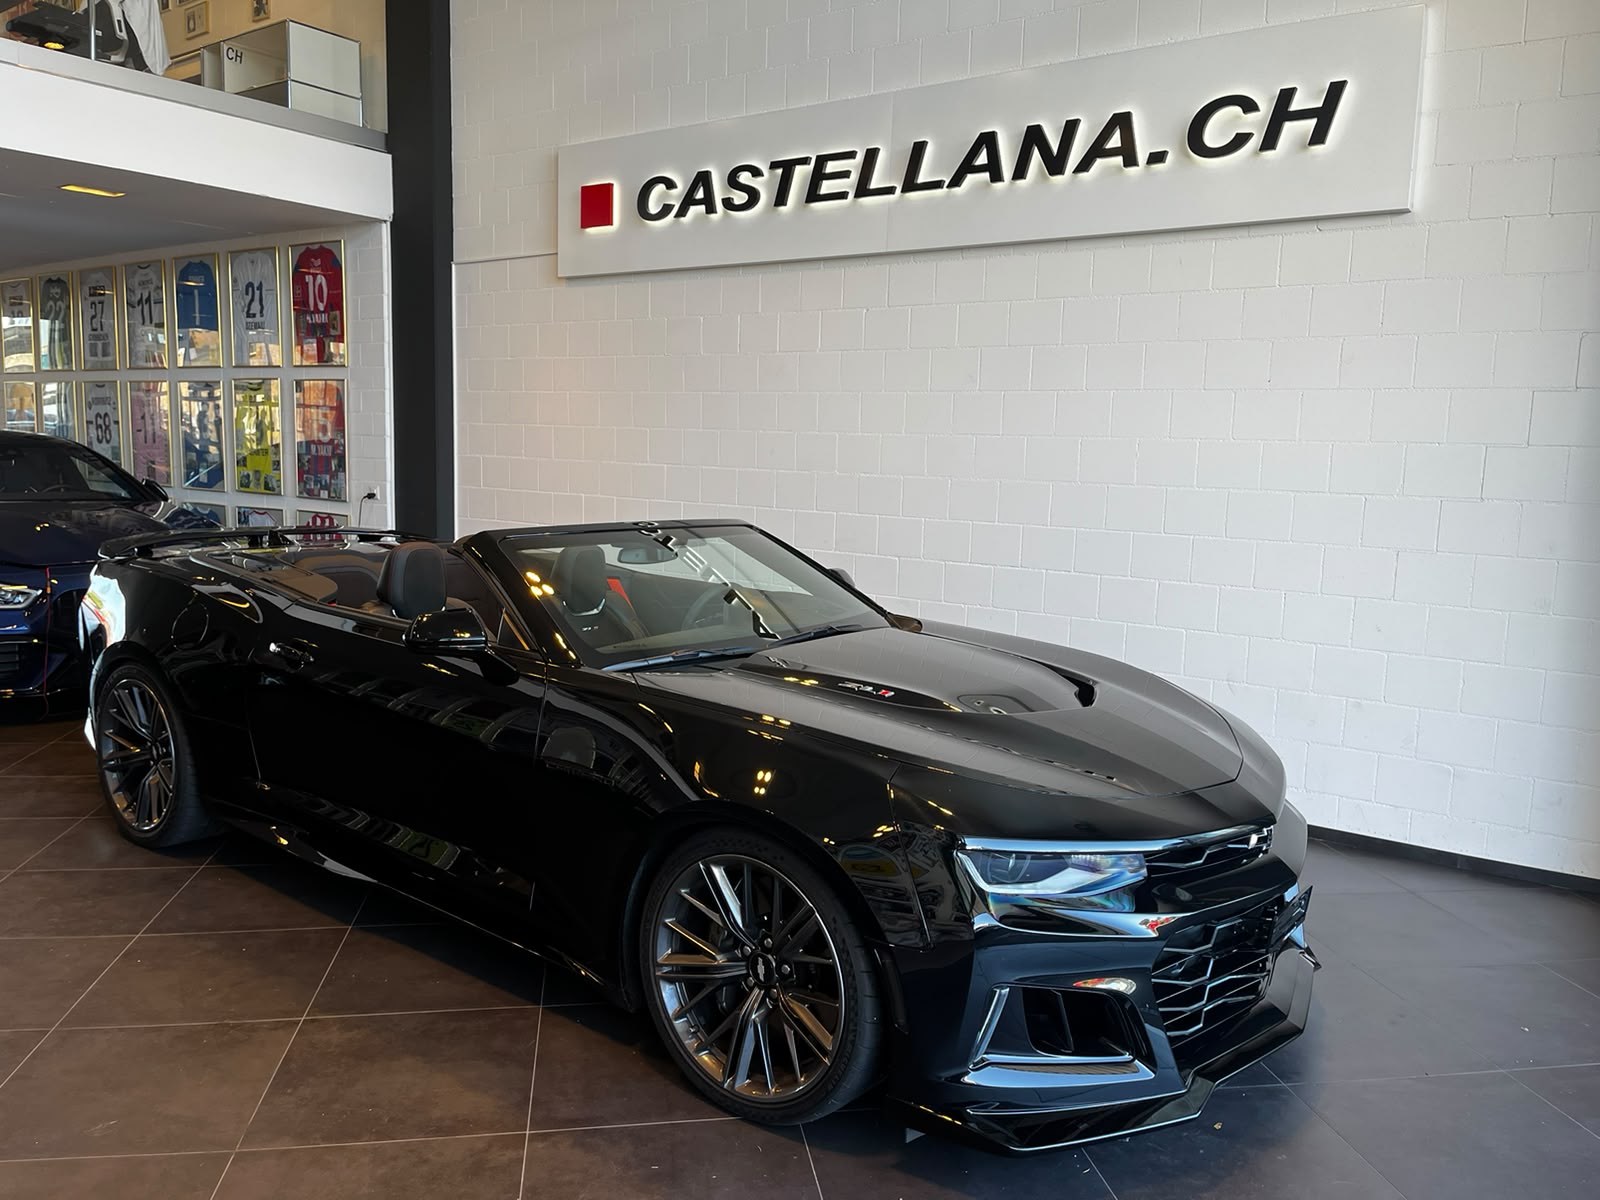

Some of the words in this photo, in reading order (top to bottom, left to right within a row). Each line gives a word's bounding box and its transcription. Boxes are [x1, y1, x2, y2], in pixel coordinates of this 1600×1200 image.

[226, 46, 243, 65] CH
[636, 79, 1348, 222] CASTELLANA.CH
[137, 290, 153, 325] 11
[245, 281, 265, 318] 21
[305, 274, 328, 311] 10
[90, 301, 104, 331] 27
[95, 412, 112, 444] 68
